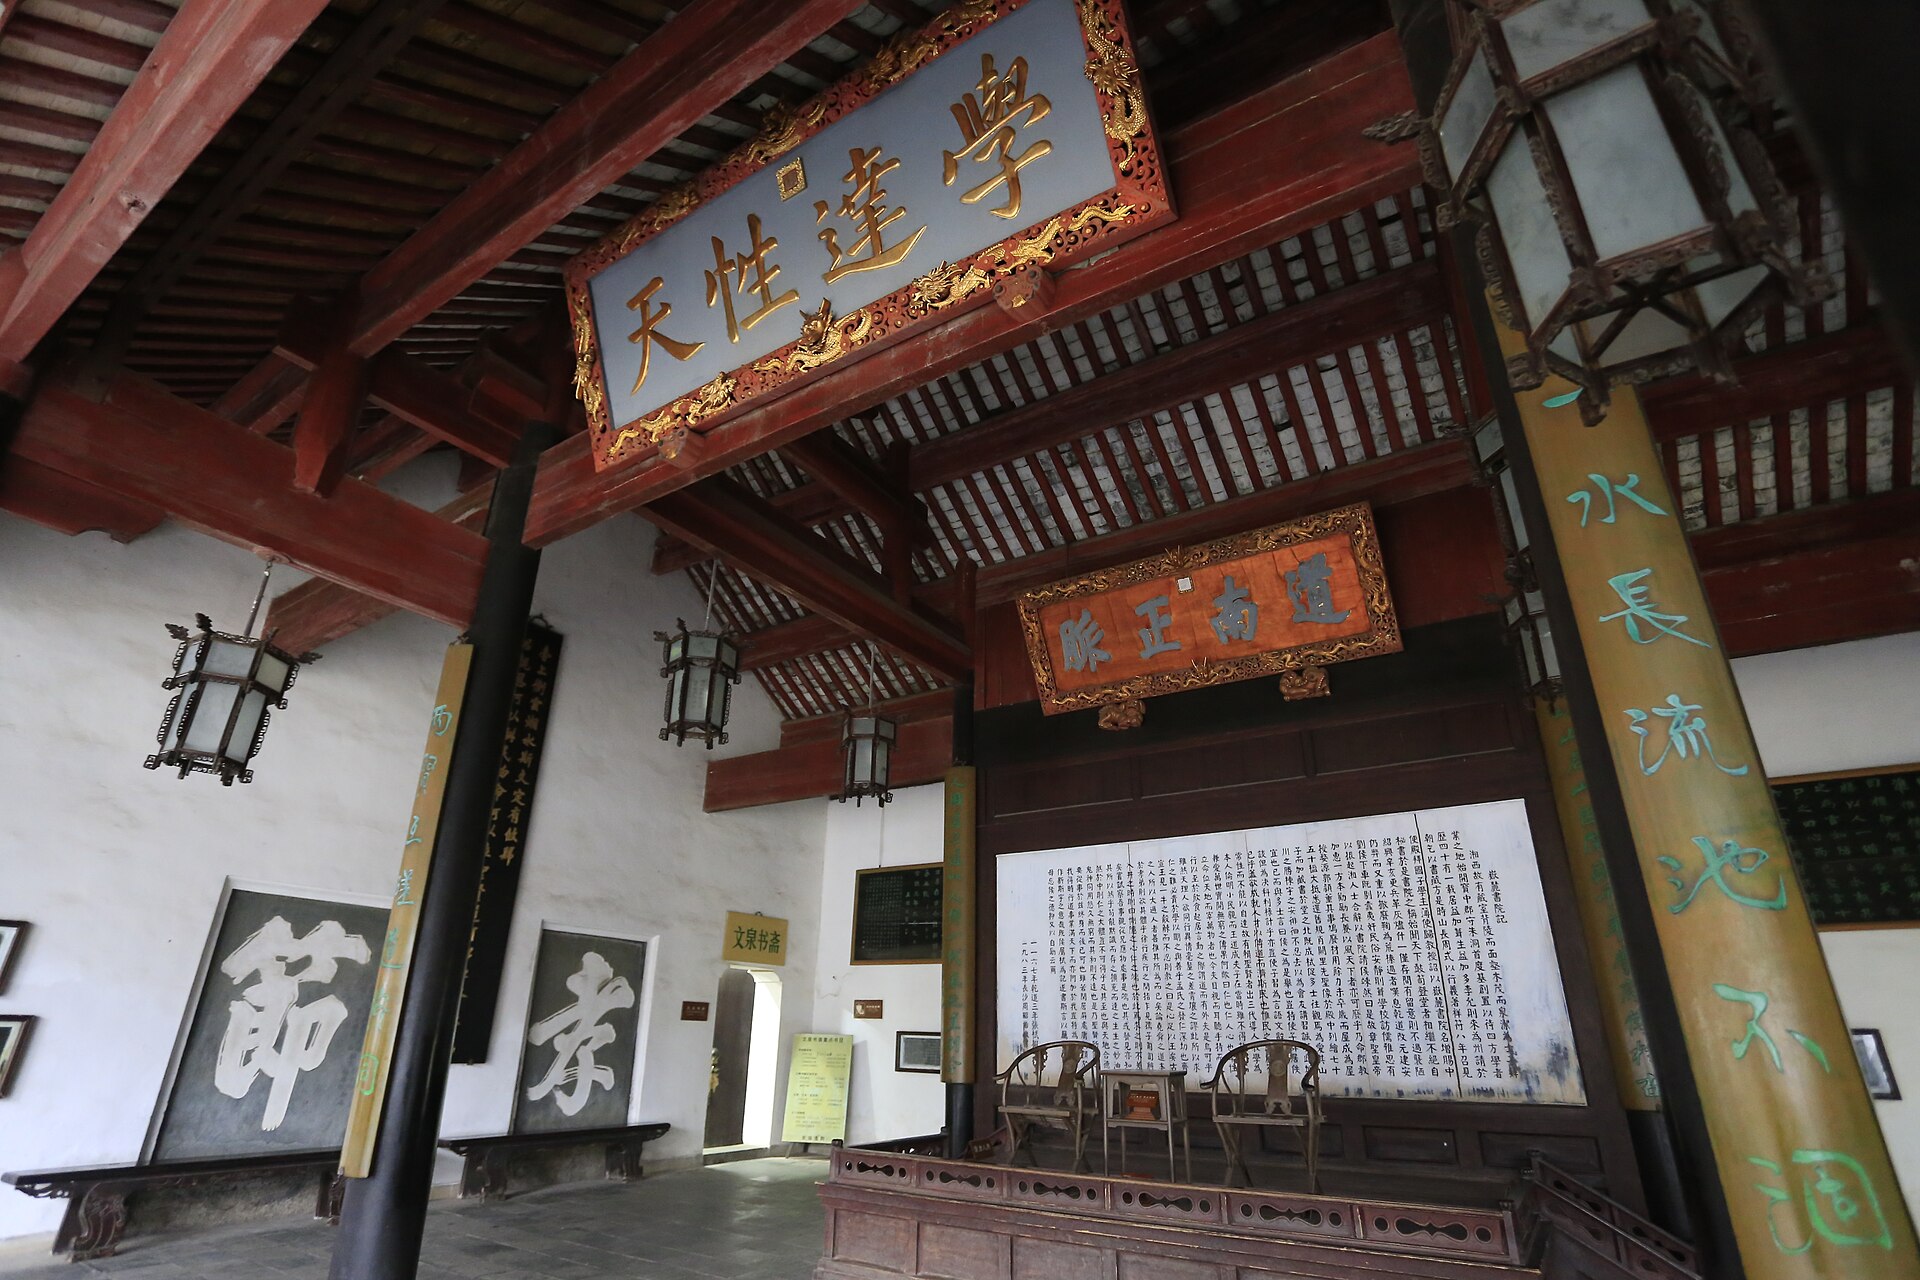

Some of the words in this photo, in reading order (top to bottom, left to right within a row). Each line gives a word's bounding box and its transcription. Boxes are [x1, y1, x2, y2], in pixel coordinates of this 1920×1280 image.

[626, 52, 1054, 396] 學達性天
[214, 915, 372, 1132] 節
[528, 951, 636, 1117] 孝
[733, 926, 781, 954] 文泉书斋
